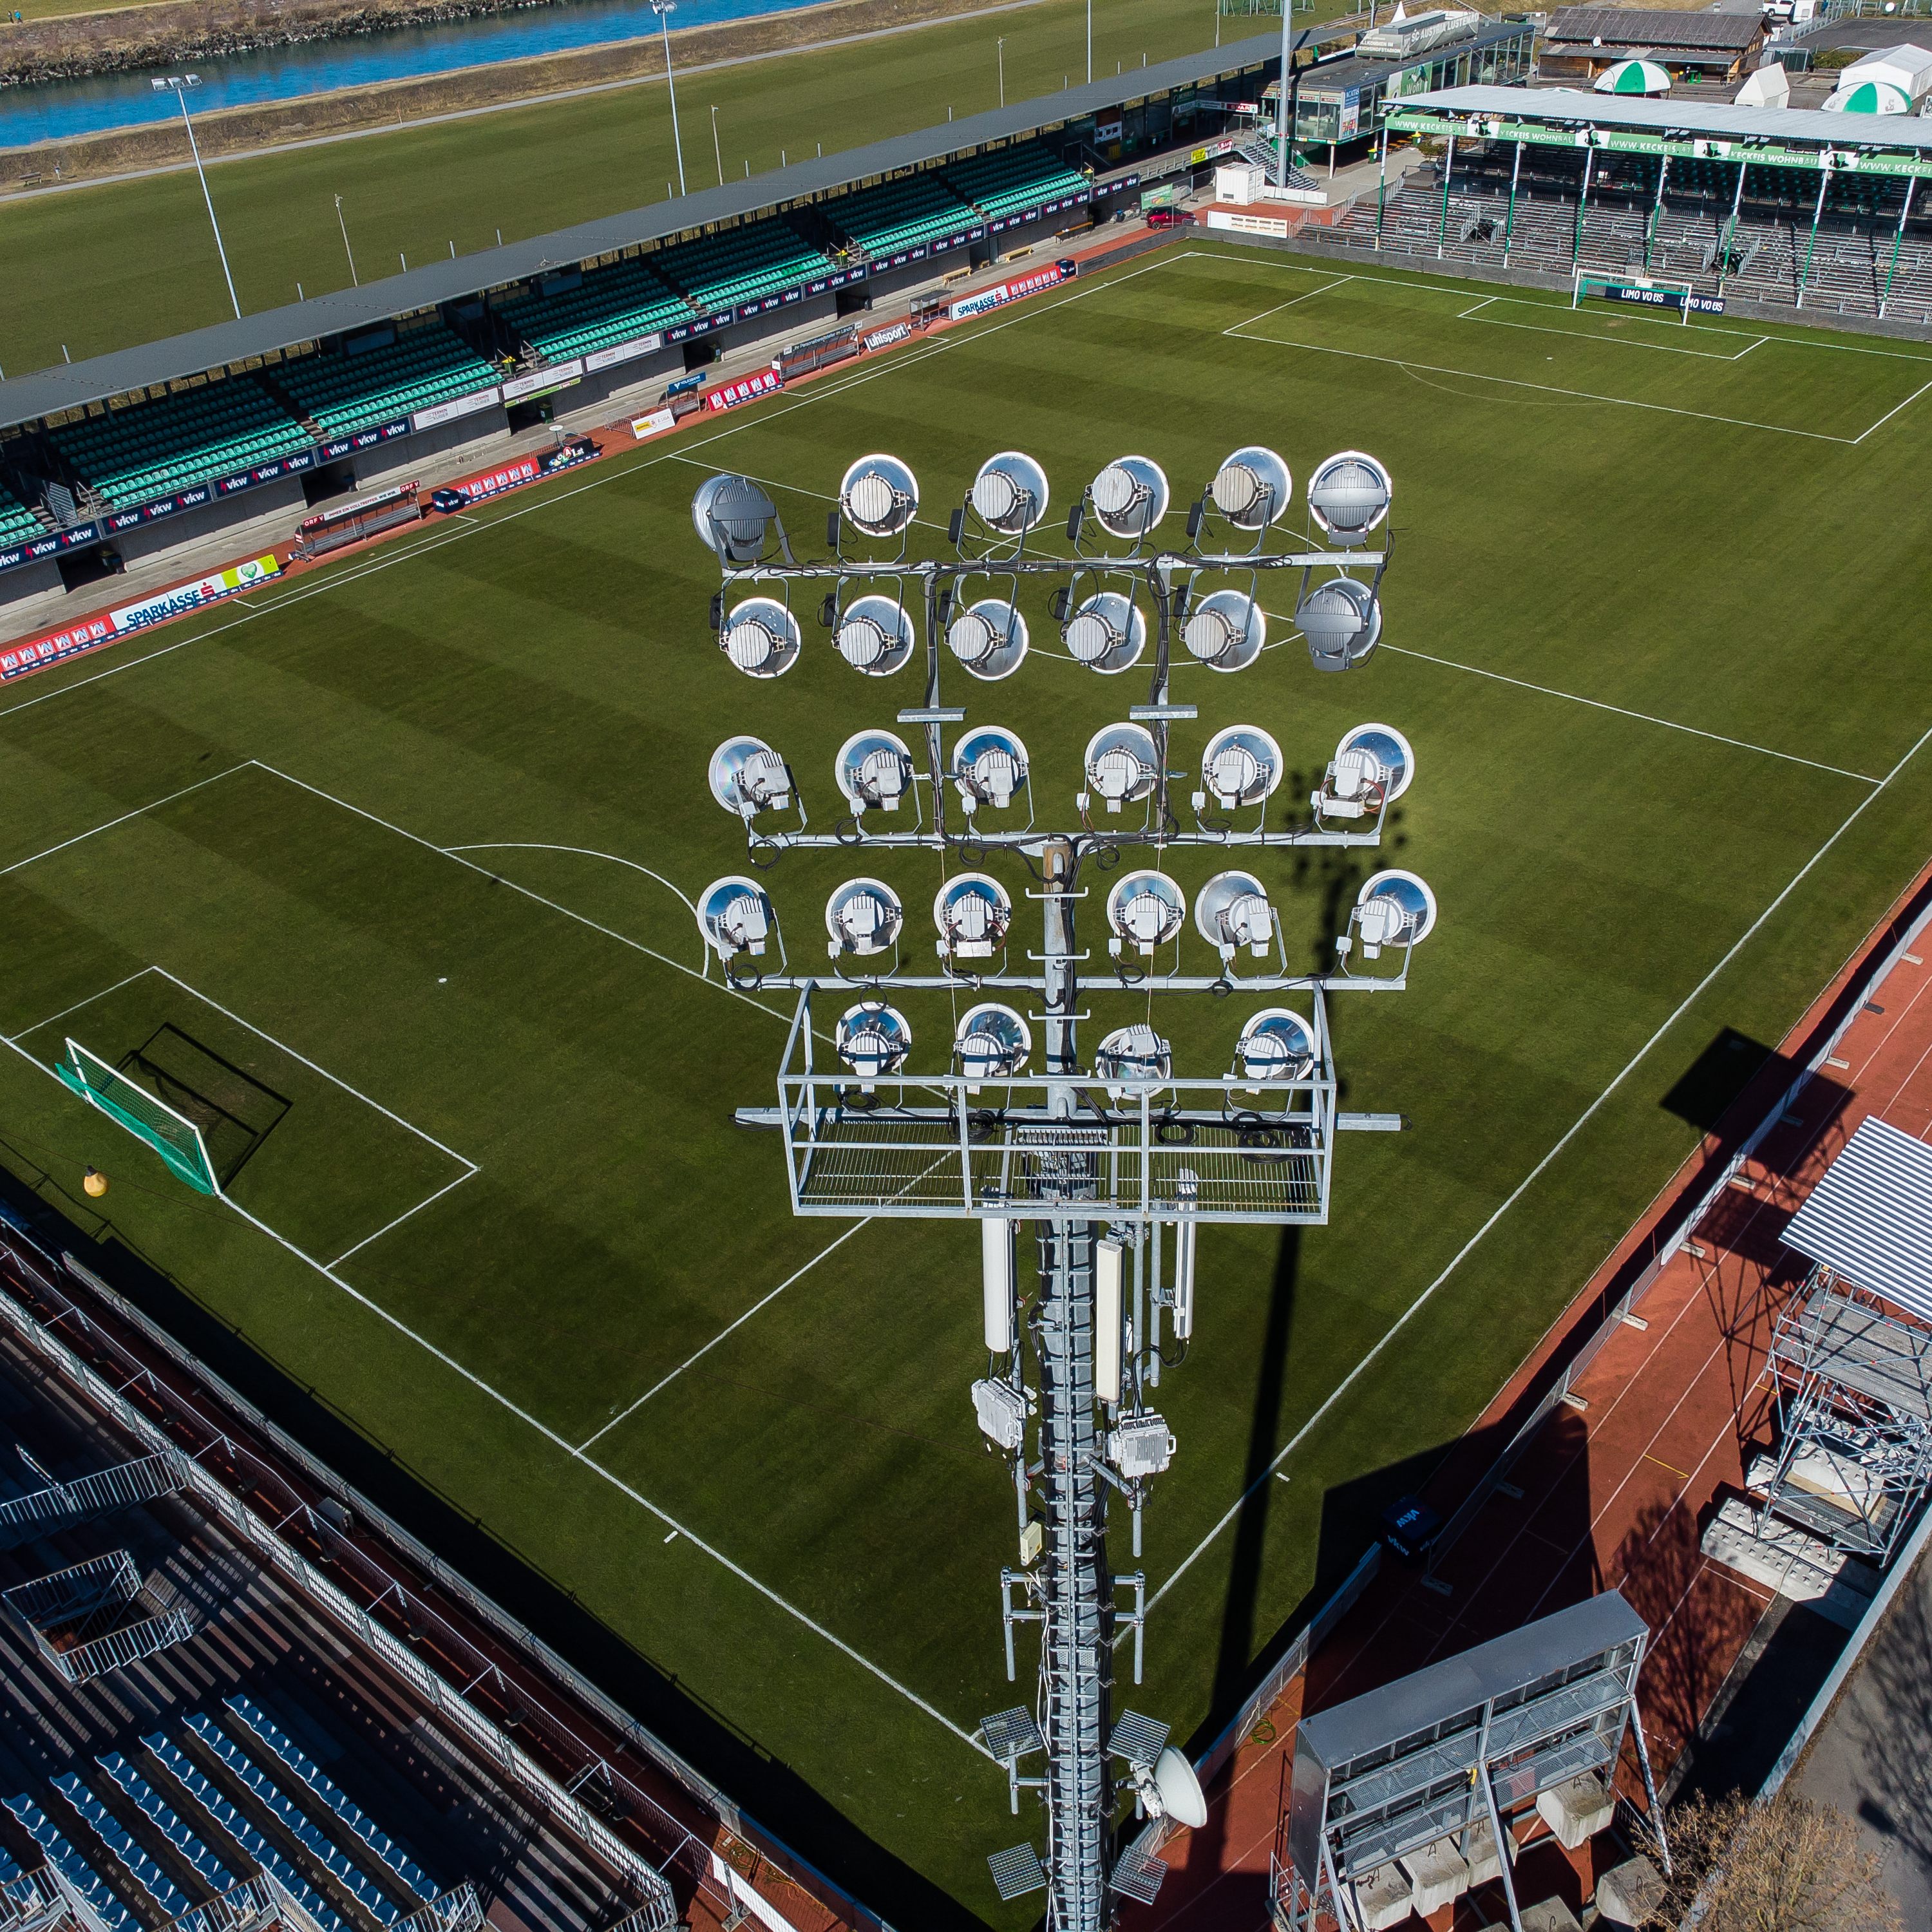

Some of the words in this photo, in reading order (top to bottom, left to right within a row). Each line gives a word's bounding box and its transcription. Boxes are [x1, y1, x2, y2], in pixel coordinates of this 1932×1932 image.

[992, 222, 1003, 231] vkw
[1009, 217, 1020, 225] vkw
[1025, 211, 1036, 220] vkw
[936, 242, 947, 250] vkw
[953, 236, 965, 244] vkw
[970, 230, 981, 238] vkw
[875, 261, 887, 270] vkw
[894, 255, 905, 264] vkw
[912, 249, 923, 258] vkw
[811, 283, 824, 292] vkw
[831, 276, 844, 285] vkw
[850, 270, 863, 279] vkw
[744, 305, 757, 315] vkw
[764, 298, 778, 308] vkw
[785, 292, 798, 301] vkw
[958, 294, 995, 316] SPARKASSE
[1621, 289, 1640, 299] LIMO
[1642, 291, 1652, 301] VO
[1701, 299, 1711, 310] VO
[671, 329, 686, 339] vkw
[694, 322, 708, 332] vkw
[715, 314, 729, 325] vkw
[869, 325, 907, 348] uhlsport
[328, 443, 348, 455] vkw
[357, 433, 376, 445] vkw
[386, 424, 404, 435] vkw
[226, 477, 247, 489] vkw
[258, 466, 278, 478] vkw
[288, 457, 308, 468] vkw
[401, 484, 413, 492] ORF
[115, 513, 137, 526] vkw
[149, 502, 171, 515] vkw
[183, 491, 204, 504] vkw
[304, 517, 318, 526] ORF
[32, 541, 55, 554] vkw
[68, 529, 91, 542] vkw
[126, 589, 200, 626] SPARKASSE
[1, 654, 18, 668] VN
[18, 648, 36, 661] VN
[37, 641, 53, 655] VN
[54, 634, 71, 649] VN
[72, 627, 88, 641] VN
[90, 621, 105, 636] VN
